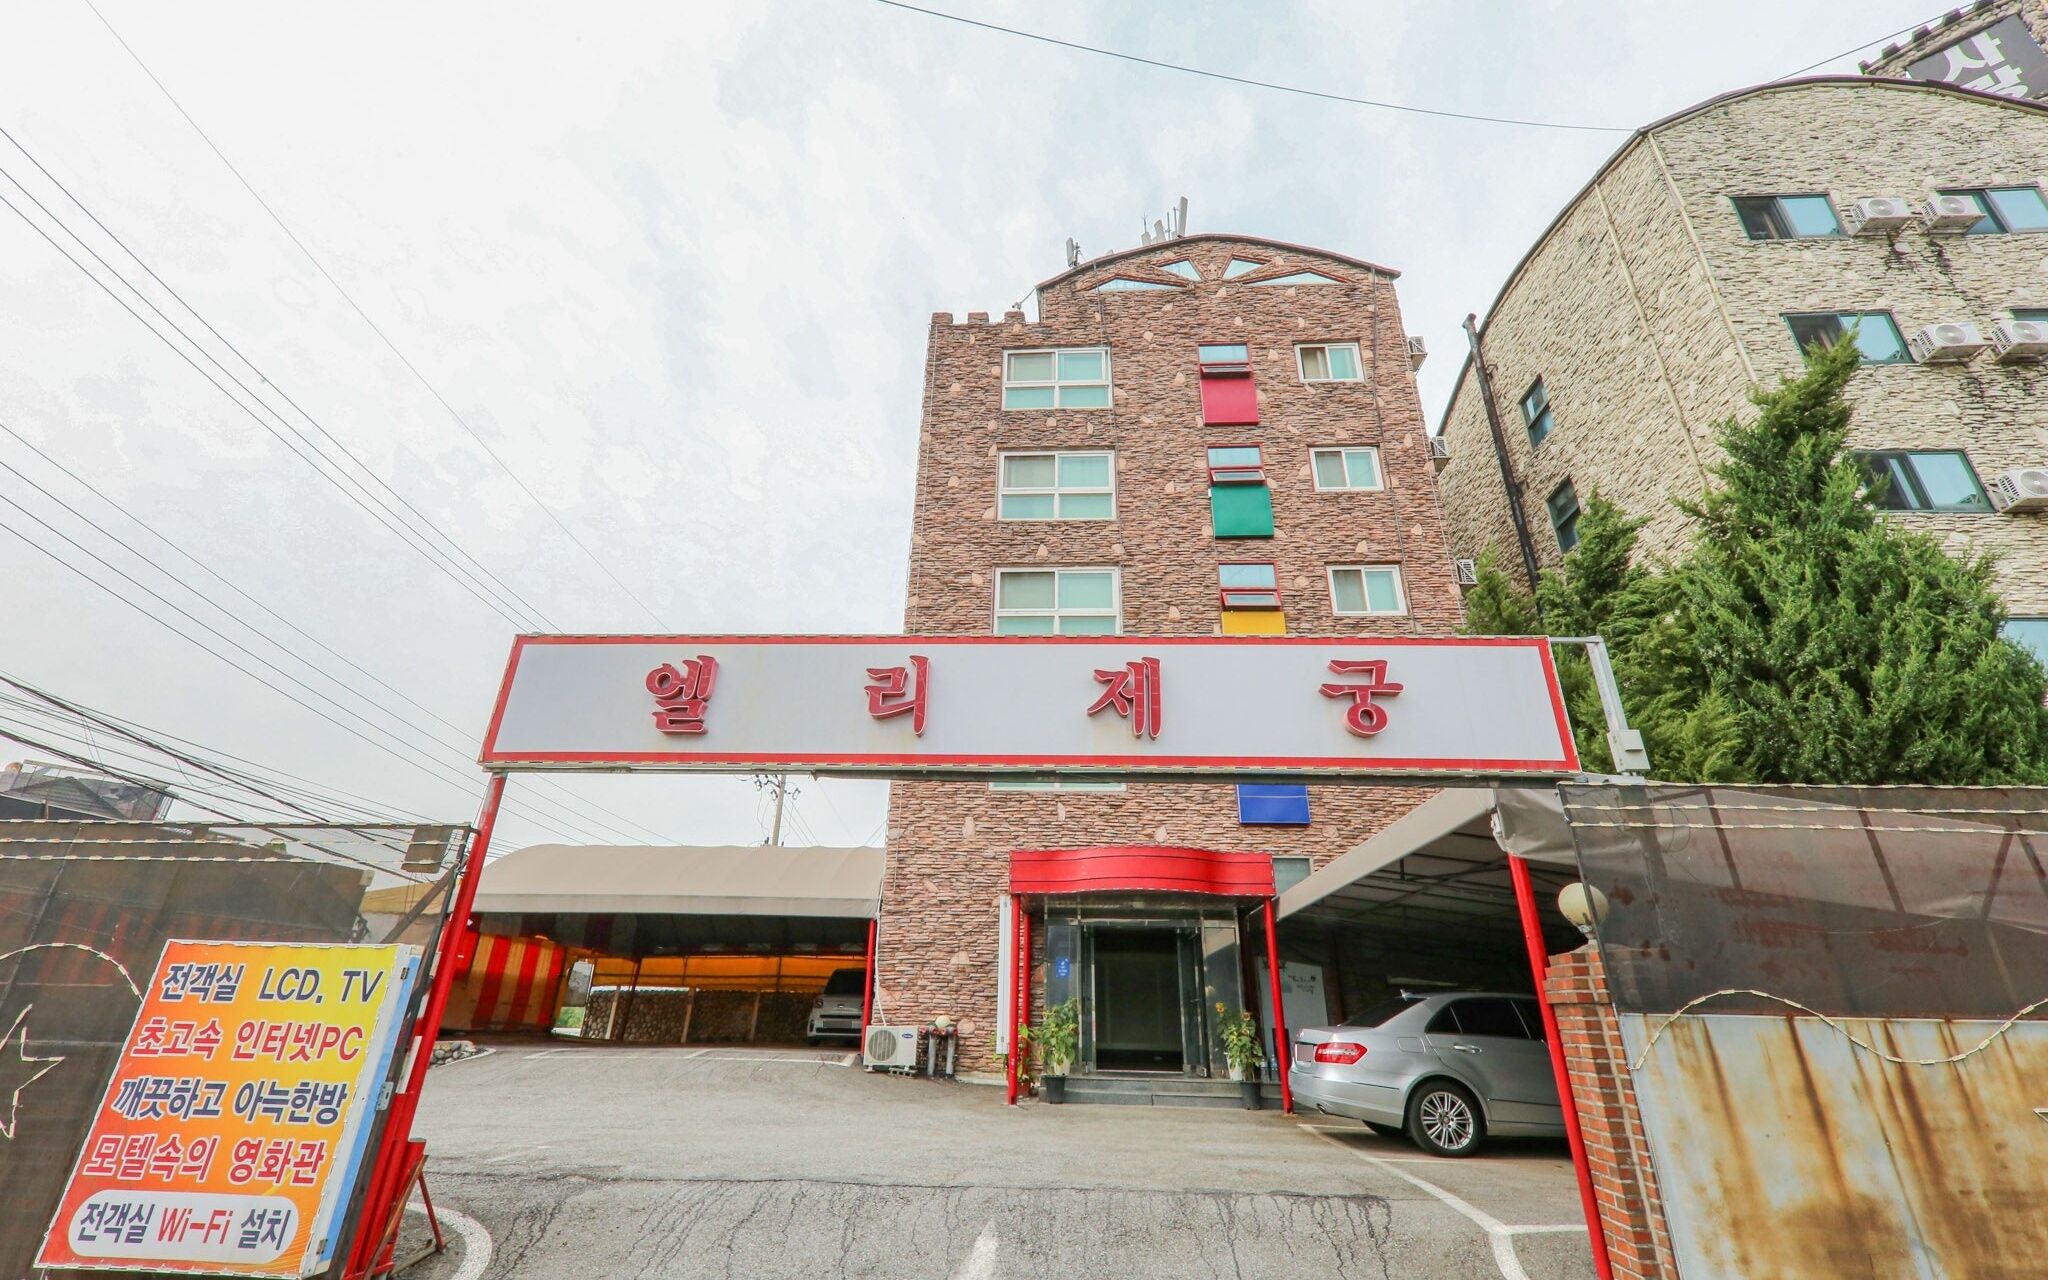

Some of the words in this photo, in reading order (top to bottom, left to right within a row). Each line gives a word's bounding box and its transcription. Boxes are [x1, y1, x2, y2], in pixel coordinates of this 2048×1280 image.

[160, 963, 245, 1001] 전객실
[340, 969, 385, 1003] TV
[132, 1017, 223, 1060] 초고속
[232, 1020, 363, 1062] 인터넷PC
[113, 1077, 227, 1121] 깨끗하고
[234, 1080, 348, 1125] 아늑한방
[83, 1135, 219, 1181] 모텔속의
[229, 1139, 326, 1185] 영화관
[77, 1201, 155, 1244] 전객실
[157, 1207, 234, 1245] Wi-Fi
[237, 1207, 292, 1251] 설치
